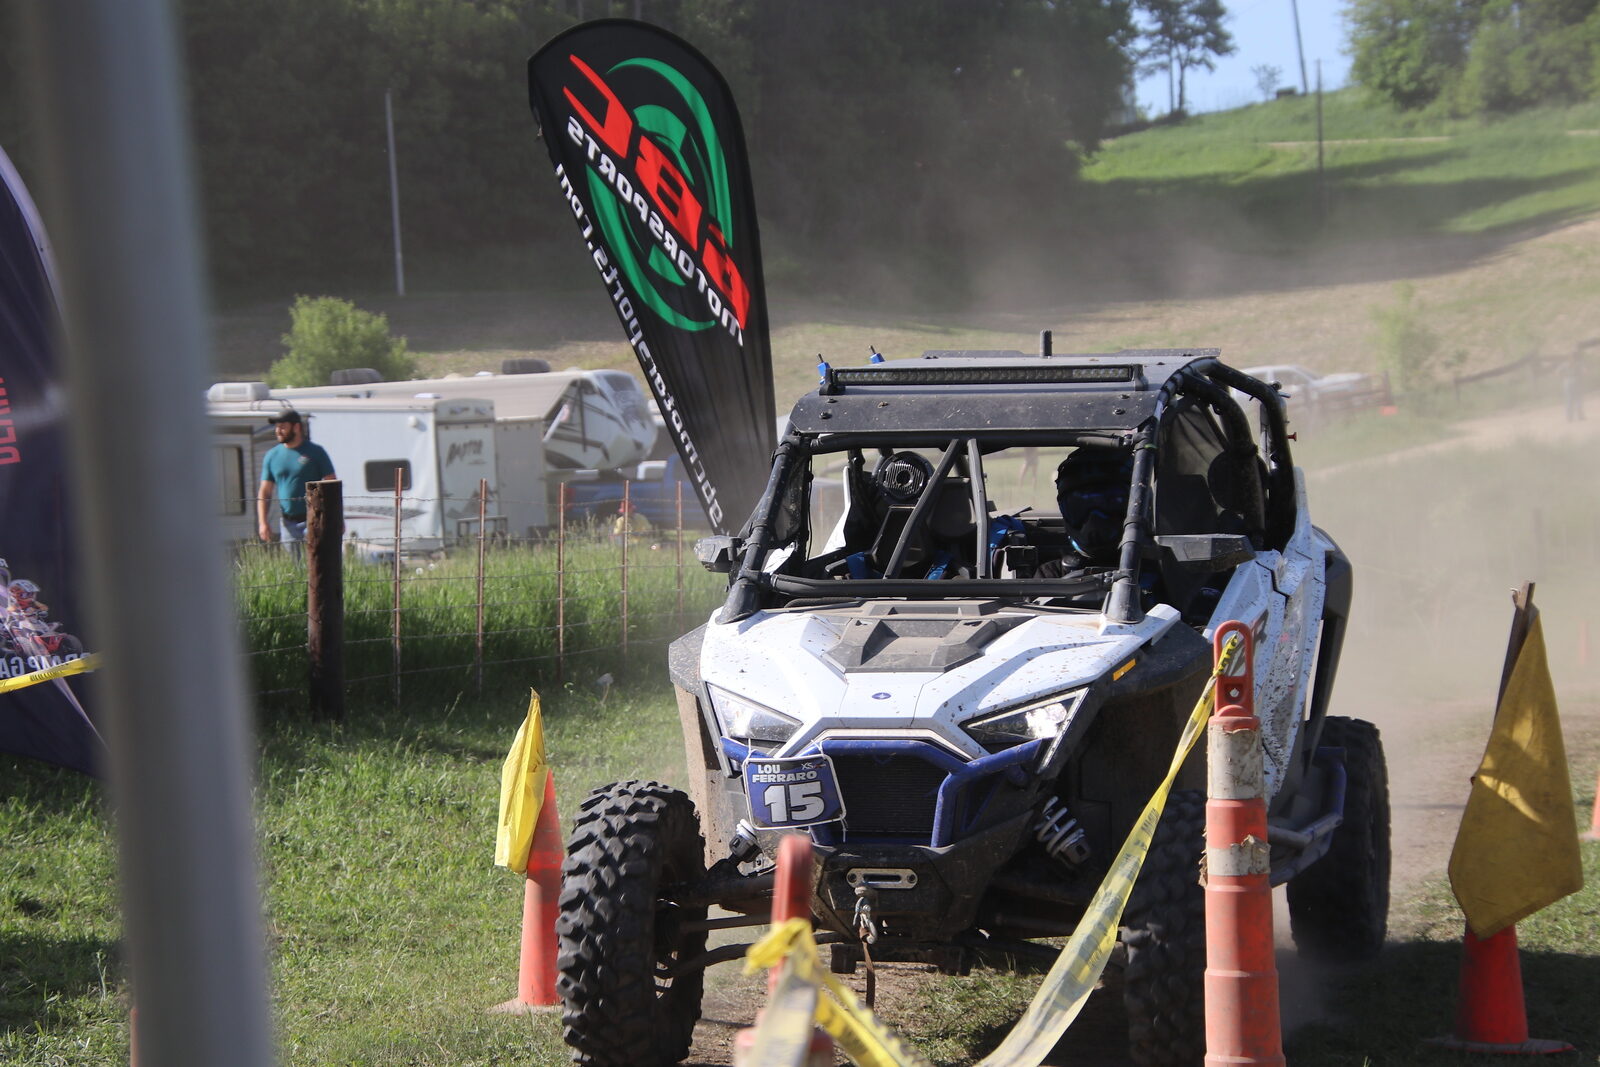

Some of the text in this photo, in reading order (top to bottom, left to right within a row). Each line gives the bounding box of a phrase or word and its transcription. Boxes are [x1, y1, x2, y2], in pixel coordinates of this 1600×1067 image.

[757, 764, 781, 774] LOU
[752, 770, 818, 783] FERRARO
[764, 780, 826, 823] 15
